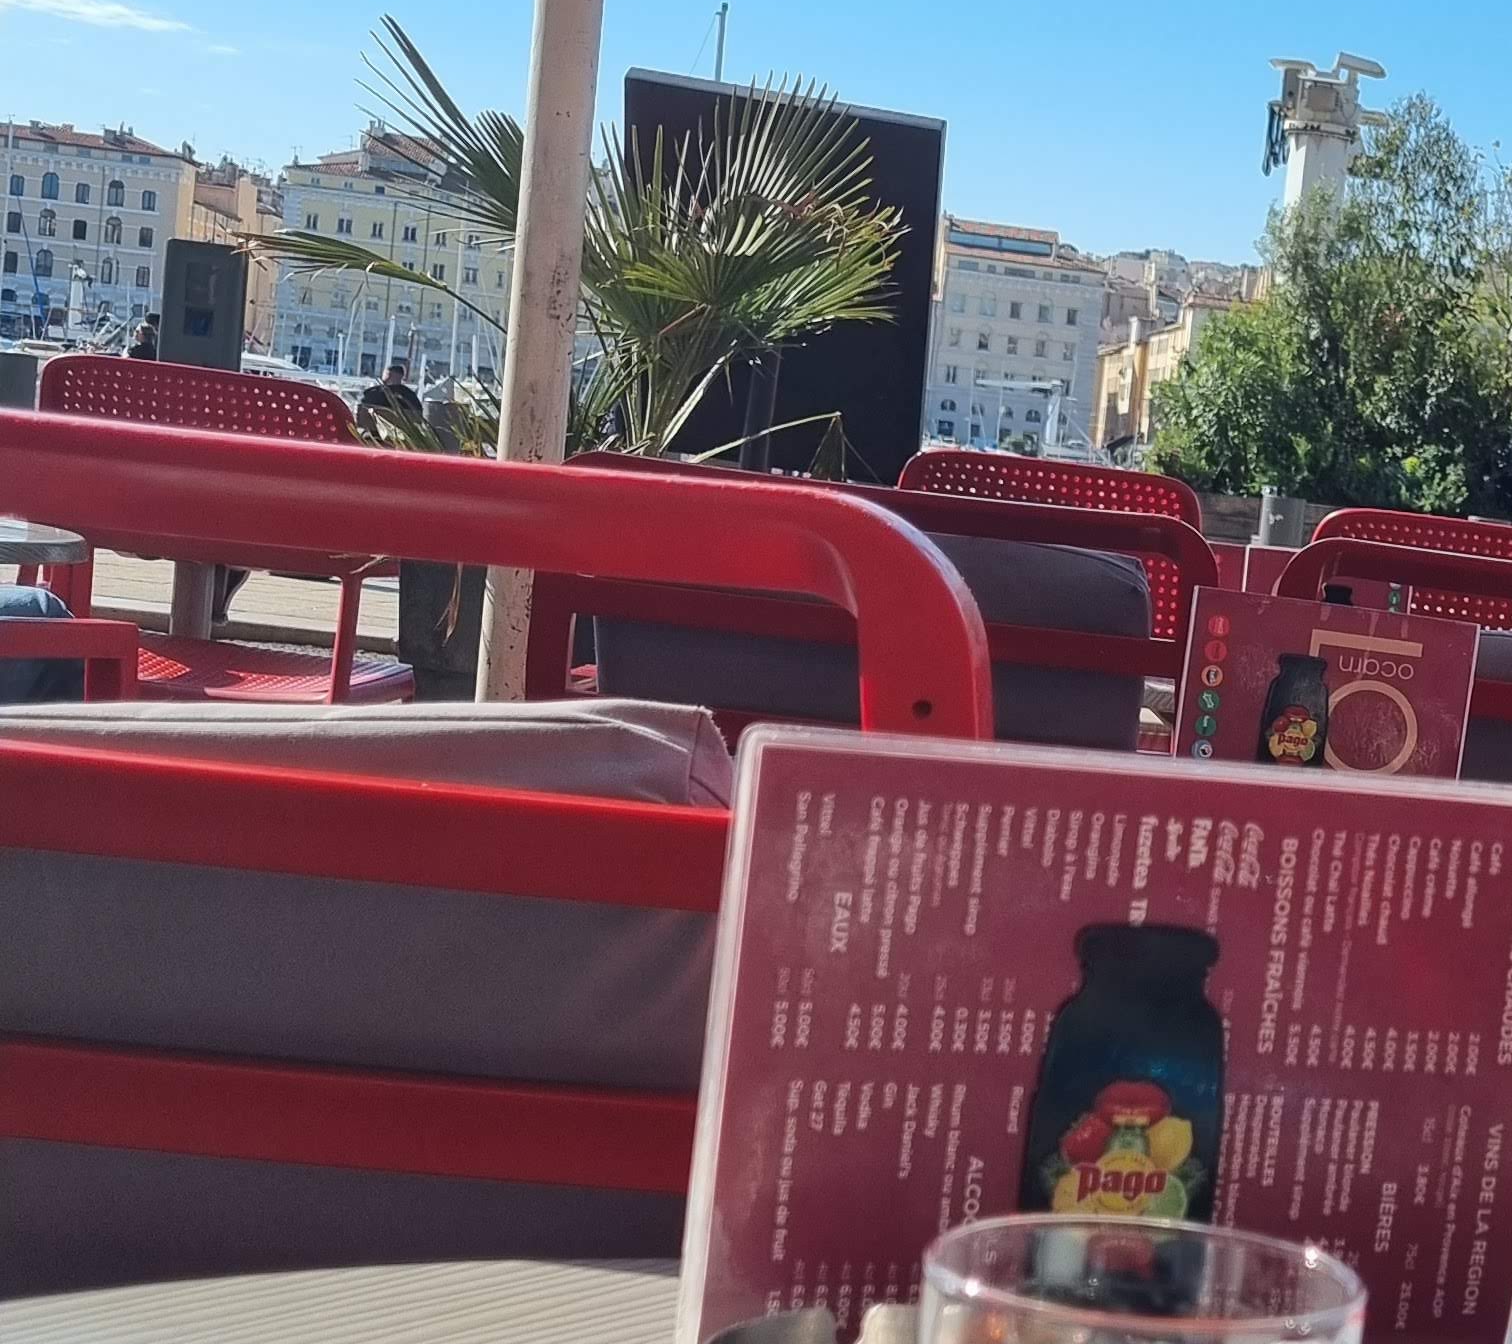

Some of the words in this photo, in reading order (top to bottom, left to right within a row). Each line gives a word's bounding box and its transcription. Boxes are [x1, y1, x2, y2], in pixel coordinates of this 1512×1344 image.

[794, 789, 812, 822] San
[887, 796, 910, 856] Orange
[916, 799, 932, 826] Jus
[1064, 809, 1083, 850] Sirop
[913, 828, 929, 850] de
[944, 801, 969, 889] Schweppes
[995, 804, 1015, 857] Perrier
[1039, 808, 1061, 868] Diabolo
[1081, 811, 1105, 881] Orangina
[1105, 813, 1127, 887] Limonade
[1130, 815, 1159, 891] fuzetea
[783, 822, 808, 904] Pellegrino
[886, 857, 901, 879] ou
[1304, 828, 1325, 893] Chocolat
[1380, 834, 1401, 898] Chocolat
[1397, 836, 1421, 920] Cappuccino
[1443, 839, 1463, 899] Noisette
[962, 895, 981, 936] sirop
[1269, 837, 1299, 945] BOISSONS
[1302, 894, 1315, 916] ou
[1321, 894, 1338, 933] Latte
[827, 889, 853, 954] EAUX
[1374, 900, 1392, 945] chaud
[1255, 948, 1289, 1054] FRAÎCHES
[811, 1079, 828, 1111] Get
[855, 1081, 875, 1130] Vodka
[880, 1081, 897, 1109] Gin
[903, 1082, 921, 1117] Jack
[923, 1083, 944, 1138] Whisky
[949, 1083, 966, 1126] Rhum
[1005, 1085, 1024, 1134] Ricard
[782, 1117, 800, 1154] soda
[808, 1111, 824, 1131] 27
[1244, 1094, 1268, 1178] Desperados
[1260, 1094, 1284, 1187] BOUTEILLES
[1312, 1097, 1332, 1155] Monaco
[1358, 1099, 1380, 1175] PRESSION
[780, 1156, 794, 1178] ou
[895, 1120, 917, 1180] Daniel's
[944, 1129, 961, 1169] blanc
[1482, 1122, 1504, 1171] VINS
[774, 1179, 793, 1202] jus
[941, 1174, 954, 1194] ou
[1286, 1184, 1304, 1221] sirop
[1337, 1162, 1355, 1212] blonde
[1477, 1175, 1496, 1203] DE
[774, 1204, 790, 1226] de
[1372, 1182, 1398, 1252] BIÈRES
[1473, 1207, 1491, 1234] LA
[770, 1227, 788, 1261] fruit
[1435, 1222, 1456, 1285] Provence
[1430, 1287, 1446, 1318] AOP
